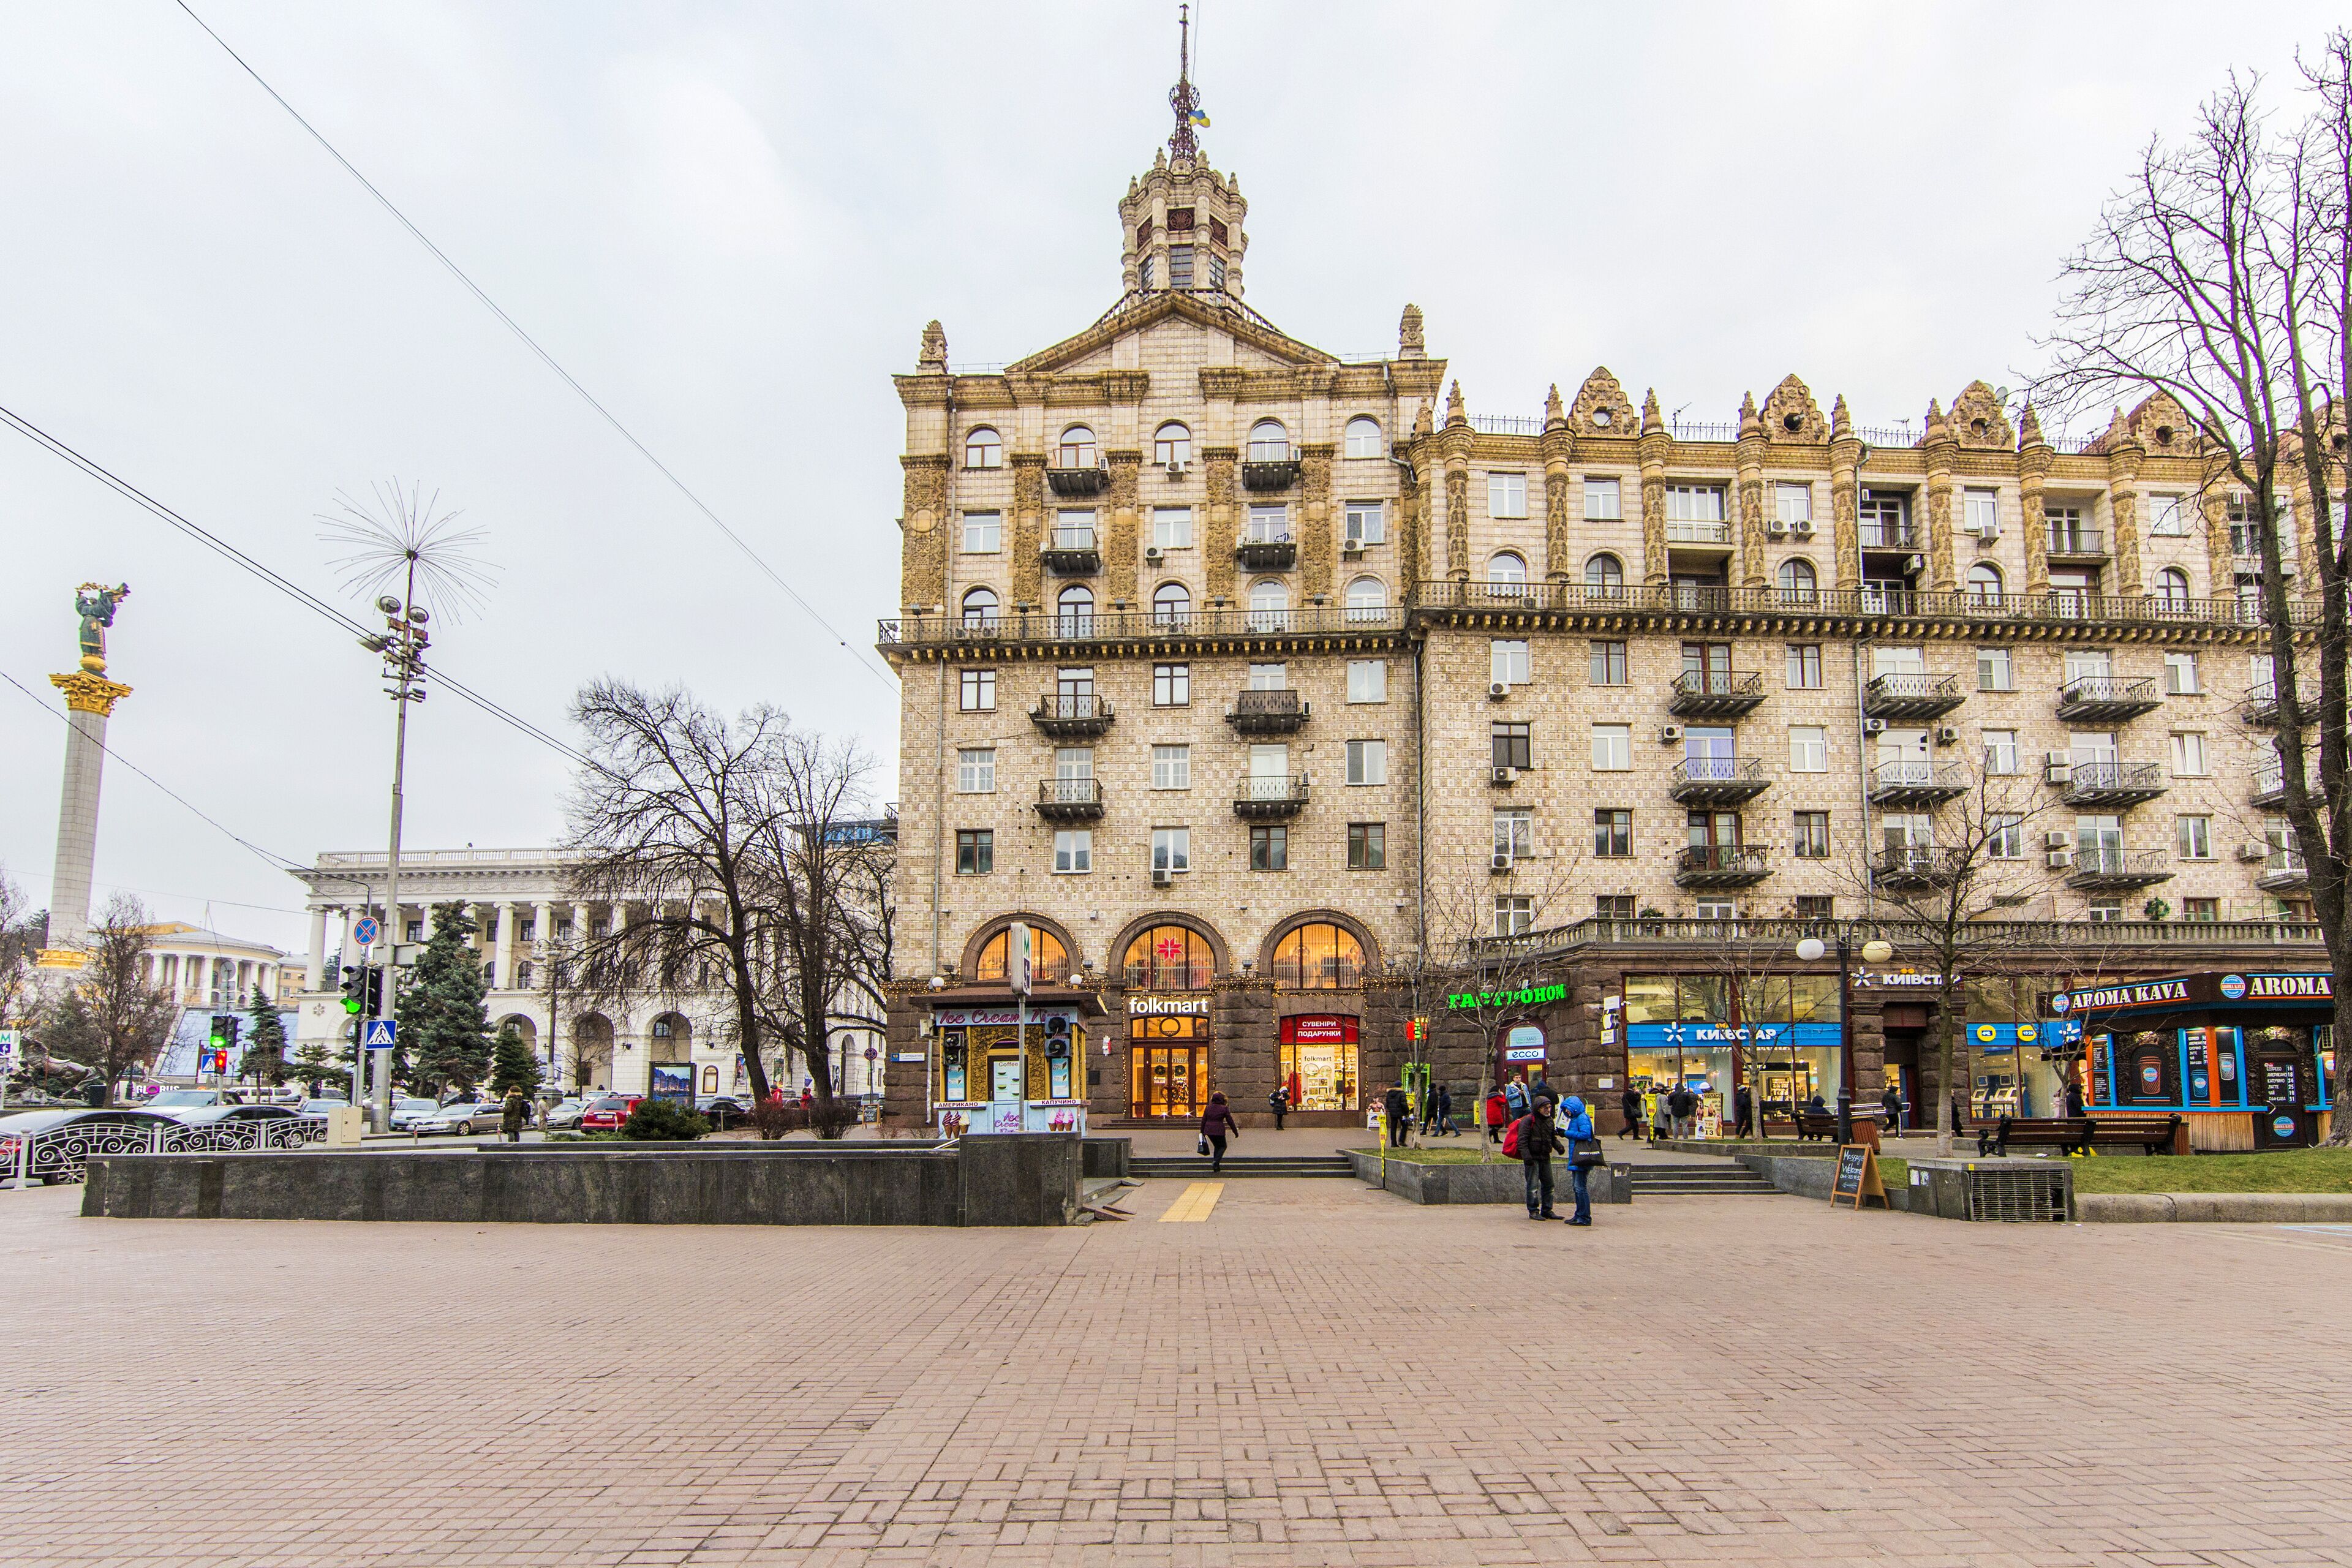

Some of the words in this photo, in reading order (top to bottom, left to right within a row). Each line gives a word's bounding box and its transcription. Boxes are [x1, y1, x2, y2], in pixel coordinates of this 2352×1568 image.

[2250, 978, 2331, 995] AROMA
[2073, 989, 2131, 1008] AROMA
[2136, 982, 2187, 1002] KAVA
[1129, 998, 1208, 1013] folkmart
[940, 1009, 965, 1024] Ice
[1843, 1149, 1864, 1165] Massage
